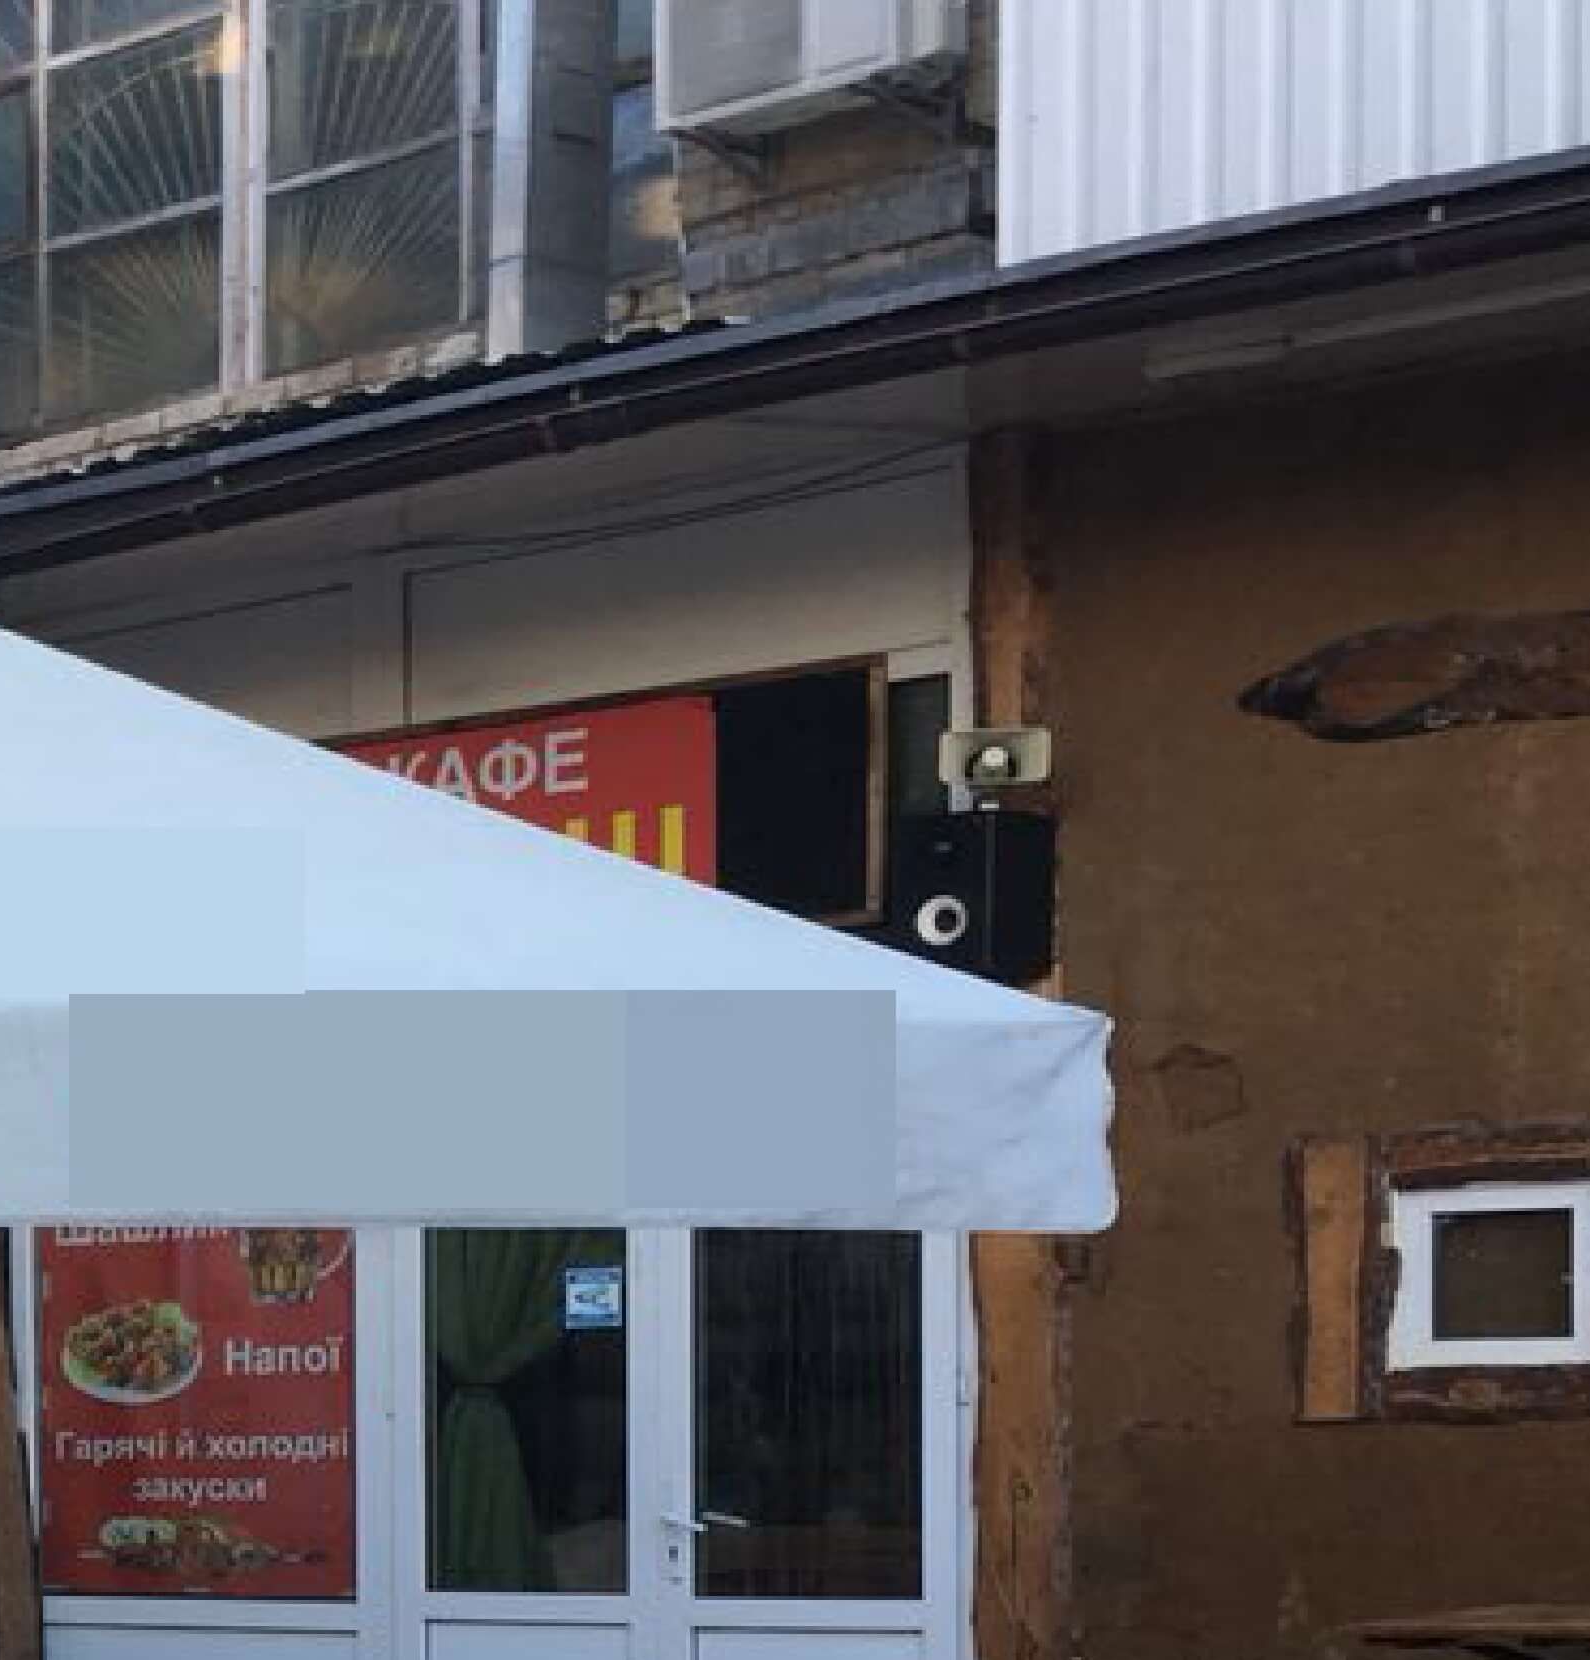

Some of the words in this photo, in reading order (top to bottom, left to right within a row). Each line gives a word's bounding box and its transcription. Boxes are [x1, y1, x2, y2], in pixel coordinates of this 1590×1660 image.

[226, 1336, 344, 1376] Напої
[55, 1430, 165, 1467] Гарячі
[205, 1427, 349, 1463] холодні
[133, 1477, 268, 1508] закуски
